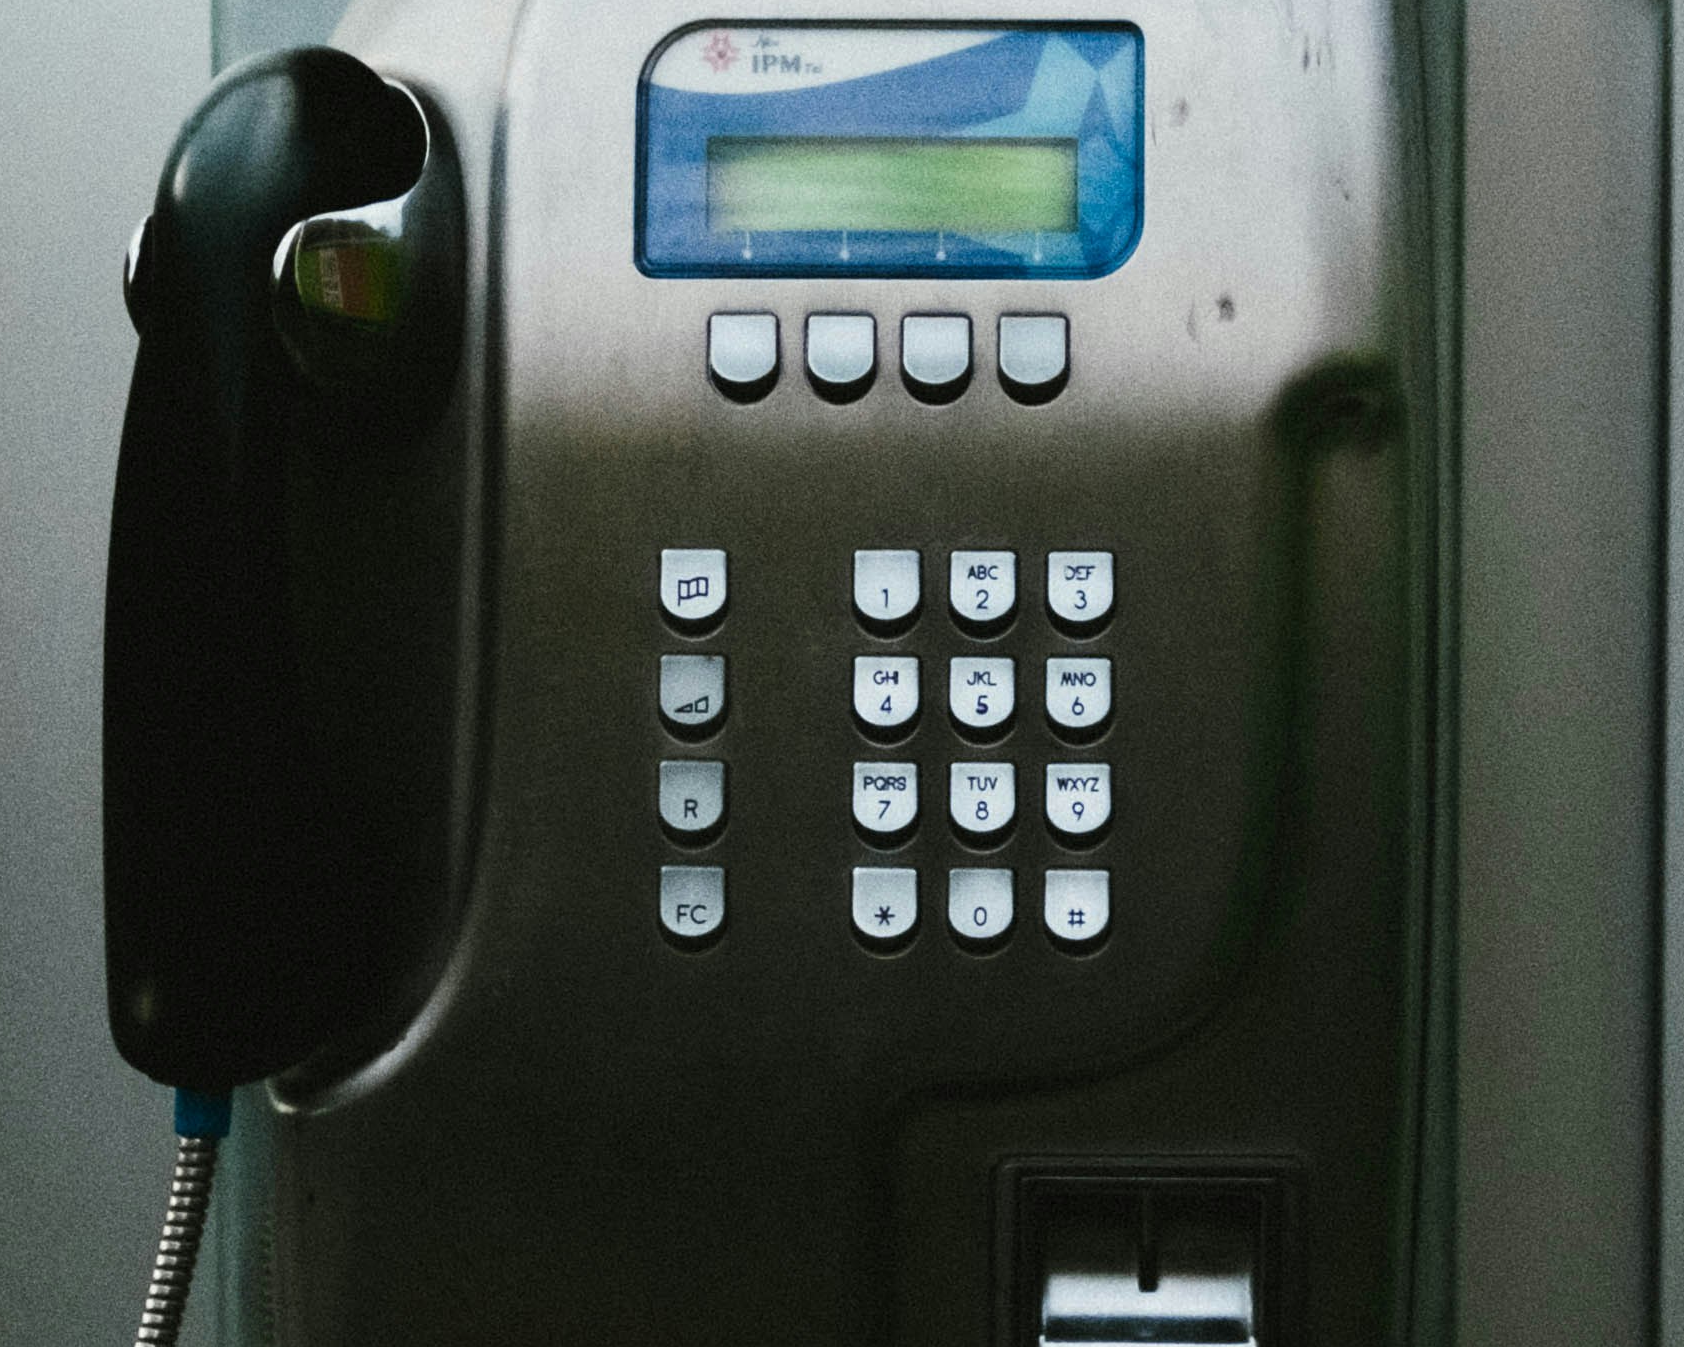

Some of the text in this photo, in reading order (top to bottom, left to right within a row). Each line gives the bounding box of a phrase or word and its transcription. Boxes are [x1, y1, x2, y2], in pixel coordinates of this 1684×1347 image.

[751, 55, 801, 74] IPM
[967, 566, 999, 580] ABC
[881, 590, 890, 608] 1
[975, 591, 989, 609] 2
[1074, 591, 1088, 609] 3
[873, 671, 900, 686] GHI
[966, 671, 997, 686] JKL
[1060, 672, 1096, 687] MNO
[880, 696, 893, 714] 4
[975, 696, 989, 715] 5
[1071, 697, 1085, 716] 6
[863, 776, 907, 792] PQRS
[967, 776, 998, 792] TUV
[1057, 777, 1099, 792] WXYZ
[684, 800, 698, 819] R
[878, 801, 891, 820] 7
[975, 801, 989, 820] 8
[1071, 802, 1084, 820] 9
[676, 905, 708, 924] FC
[973, 908, 987, 926] 0
[1068, 910, 1086, 928] #
